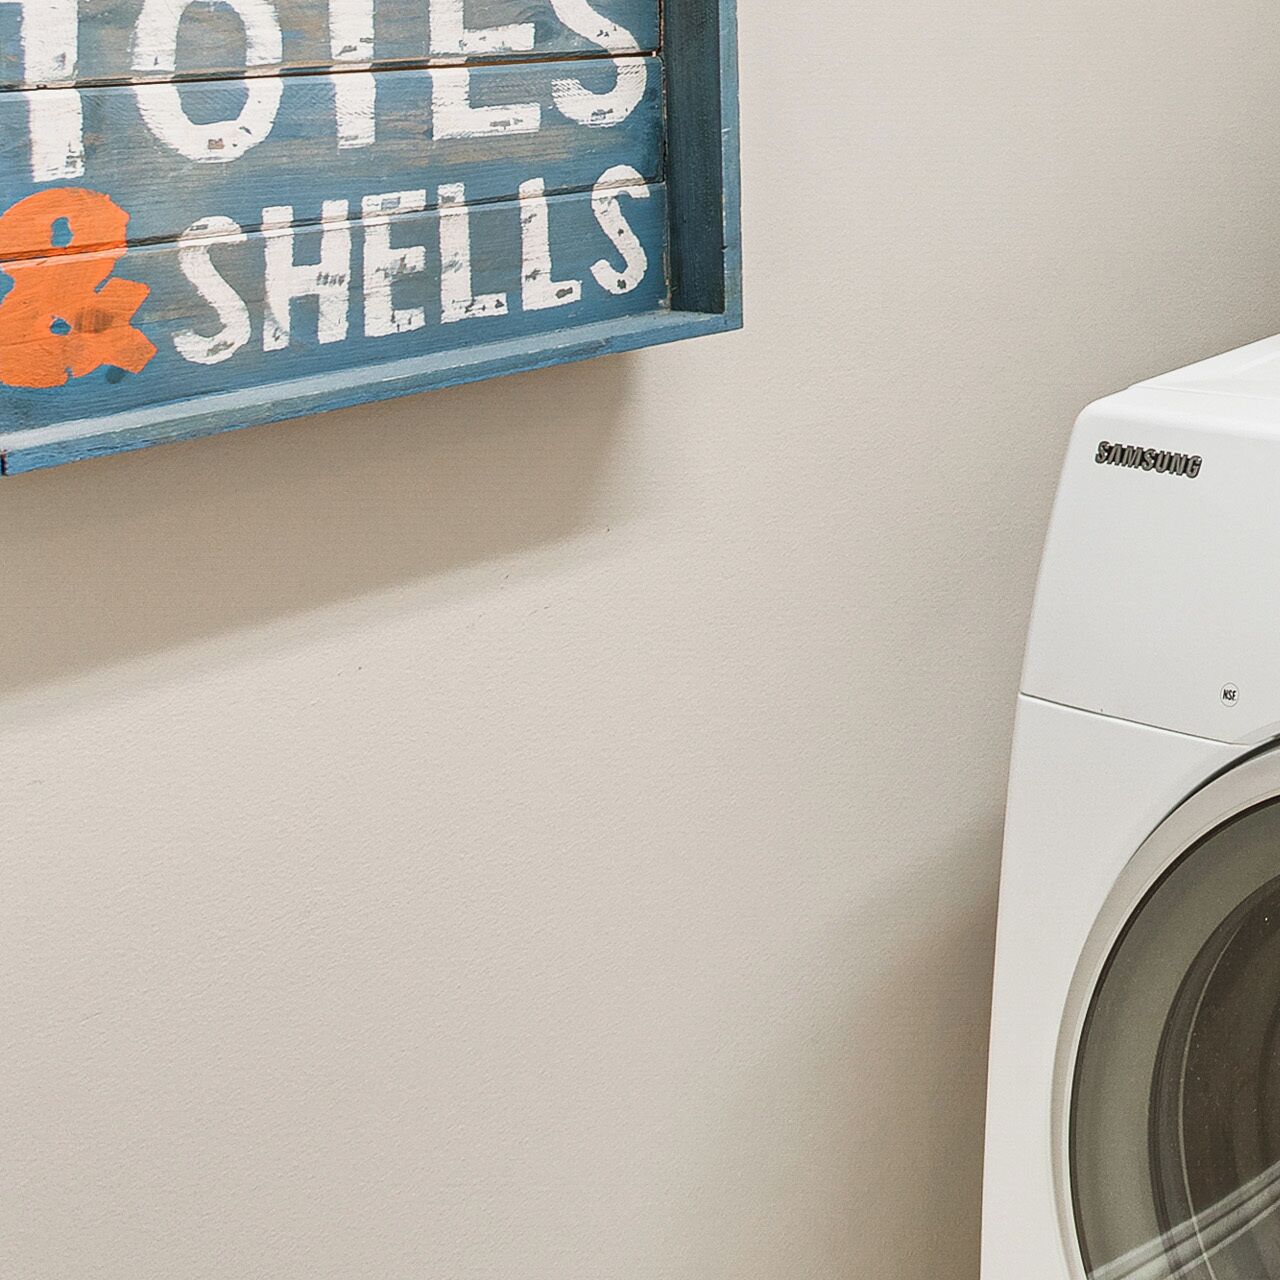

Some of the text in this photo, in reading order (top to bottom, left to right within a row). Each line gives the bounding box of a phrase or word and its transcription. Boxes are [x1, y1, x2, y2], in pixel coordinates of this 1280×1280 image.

[0, 164, 650, 388] & SHELLS
[1095, 440, 1203, 479] SAMSUNG
